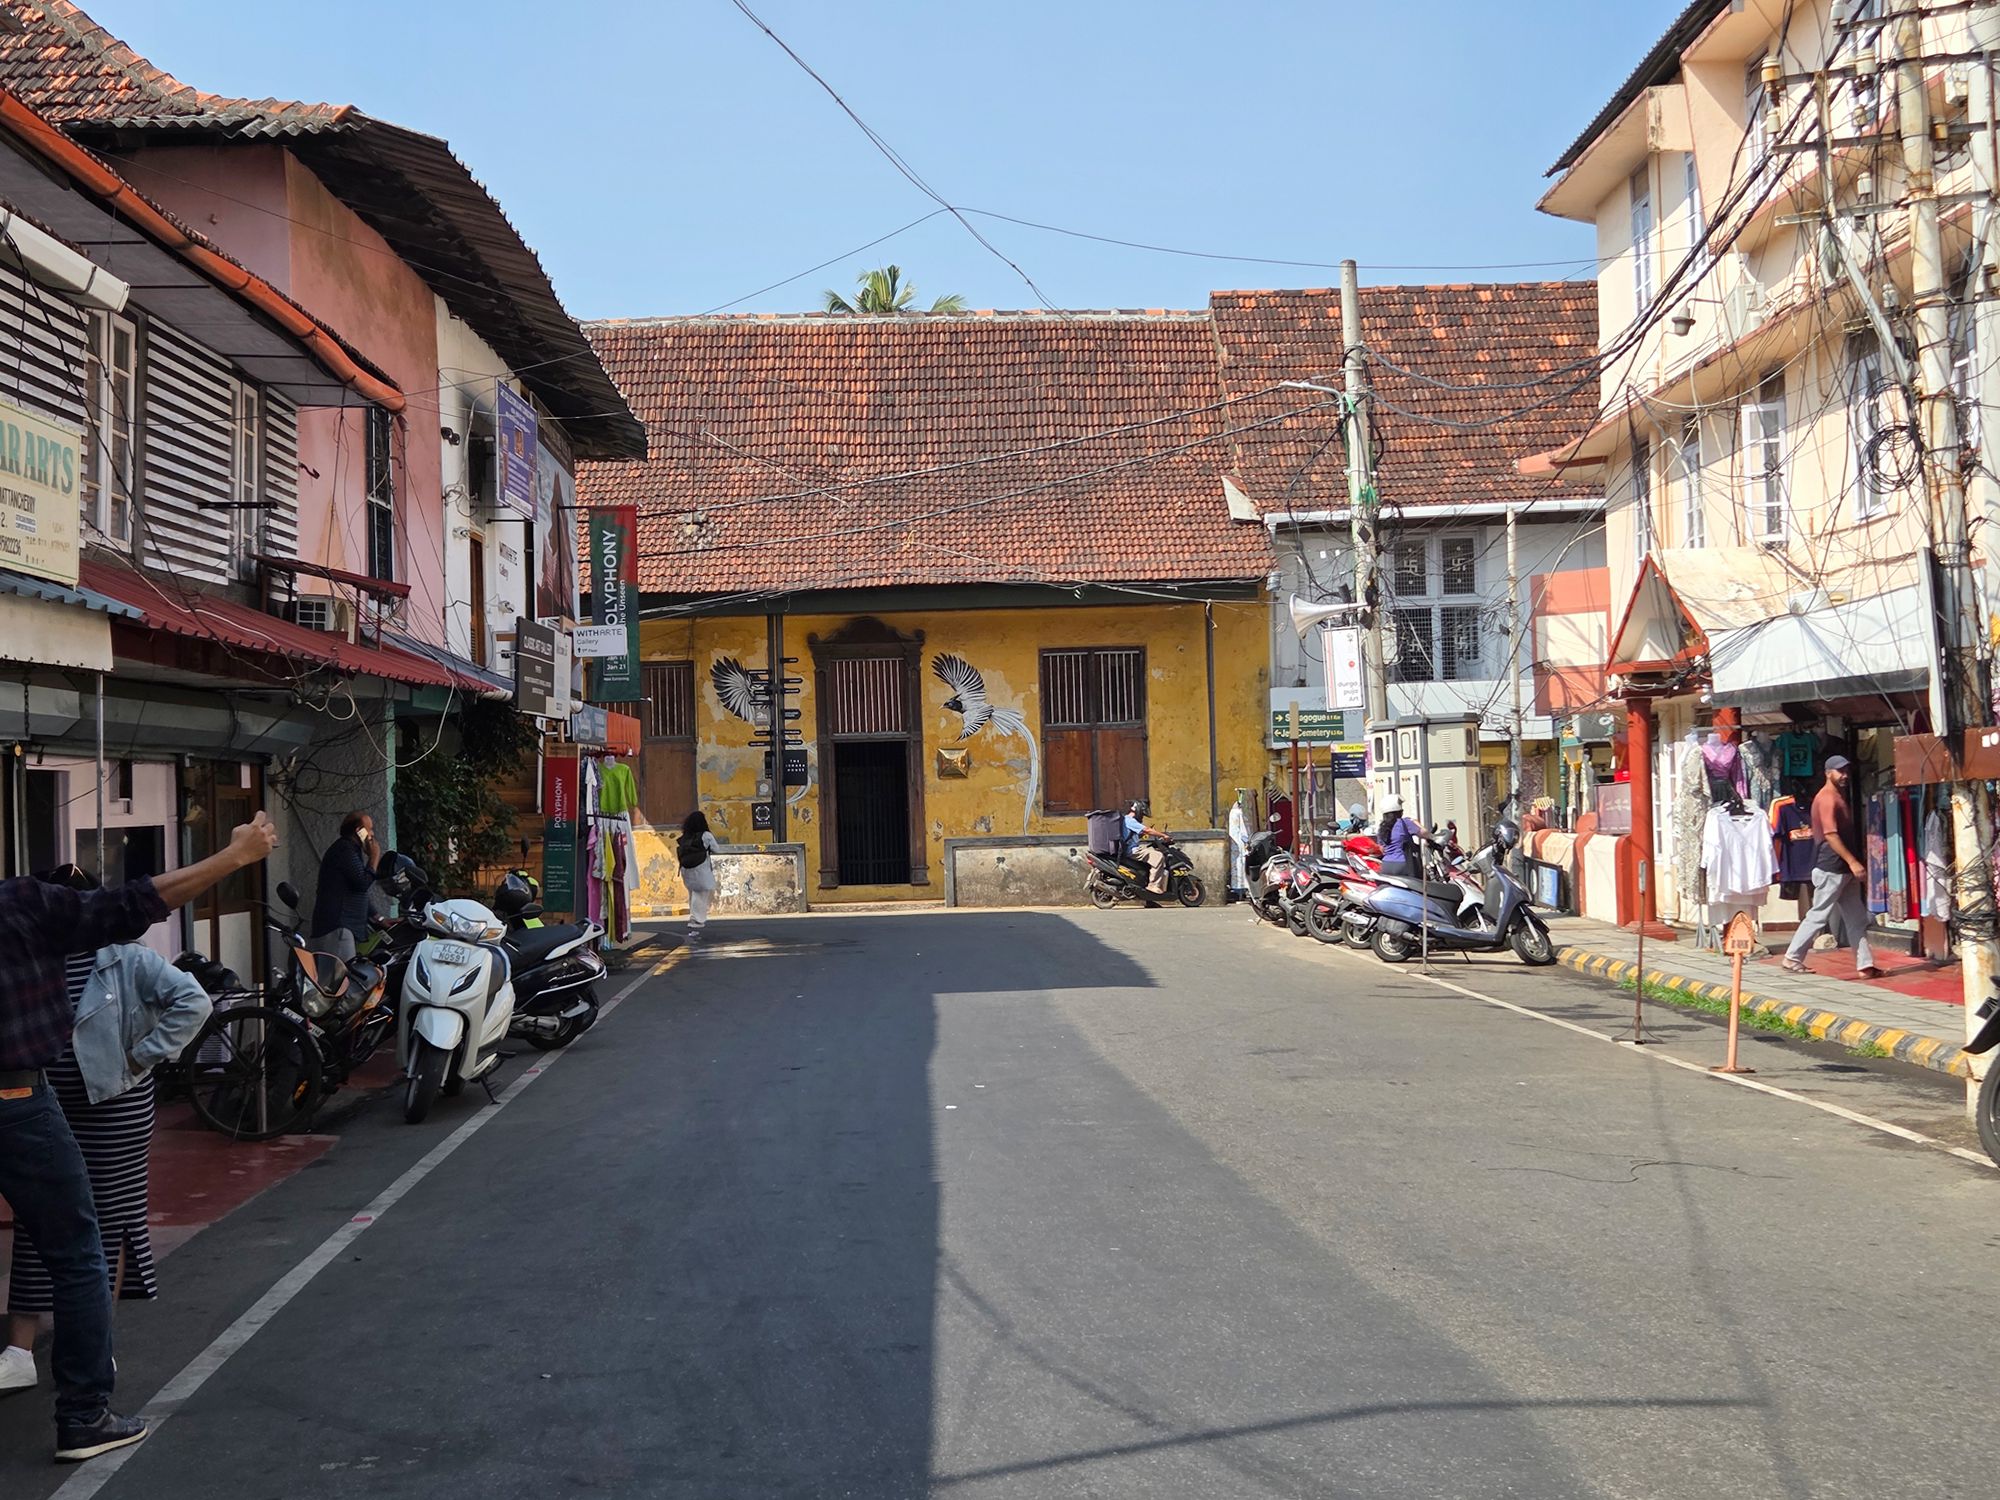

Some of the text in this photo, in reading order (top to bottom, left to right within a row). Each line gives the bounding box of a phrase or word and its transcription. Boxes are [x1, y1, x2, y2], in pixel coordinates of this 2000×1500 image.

[23, 429, 74, 496] ARTS
[602, 529, 618, 625] OLYPHONY
[618, 579, 626, 611] Unseen
[576, 638, 599, 646] Gallery
[1285, 713, 1326, 723] Sagogue
[1298, 728, 1331, 738] Cemetery
[554, 777, 563, 828] POLYPHONY
